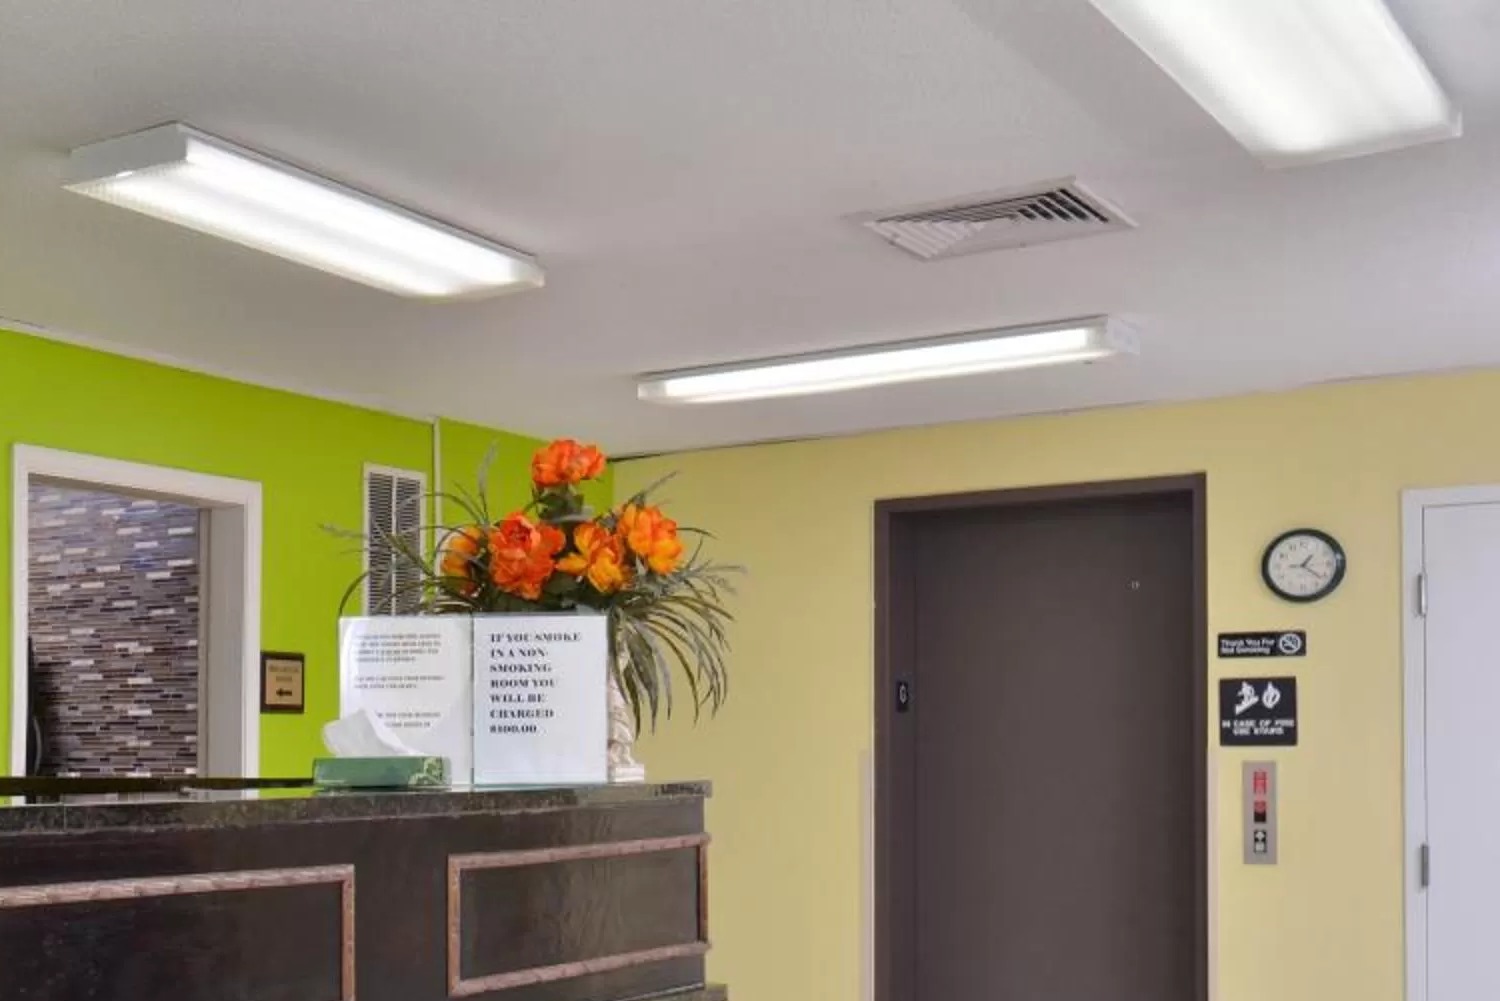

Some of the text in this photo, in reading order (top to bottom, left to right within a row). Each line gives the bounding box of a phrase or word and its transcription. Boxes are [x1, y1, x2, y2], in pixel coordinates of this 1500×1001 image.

[490, 631, 581, 643] IF YOU SMOKE
[1221, 637, 1275, 648] Thank You For
[490, 648, 505, 658] IN
[508, 648, 516, 657] A
[489, 663, 552, 673] SMOKING
[490, 678, 557, 688] ROOM YOU
[490, 693, 546, 703] WILL BE
[489, 708, 555, 719] CHARGED
[1233, 719, 1256, 728] CASE
[1259, 719, 1272, 728] OF
[1274, 718, 1295, 728] FIRE
[1233, 727, 1285, 736] USE STAIRS
